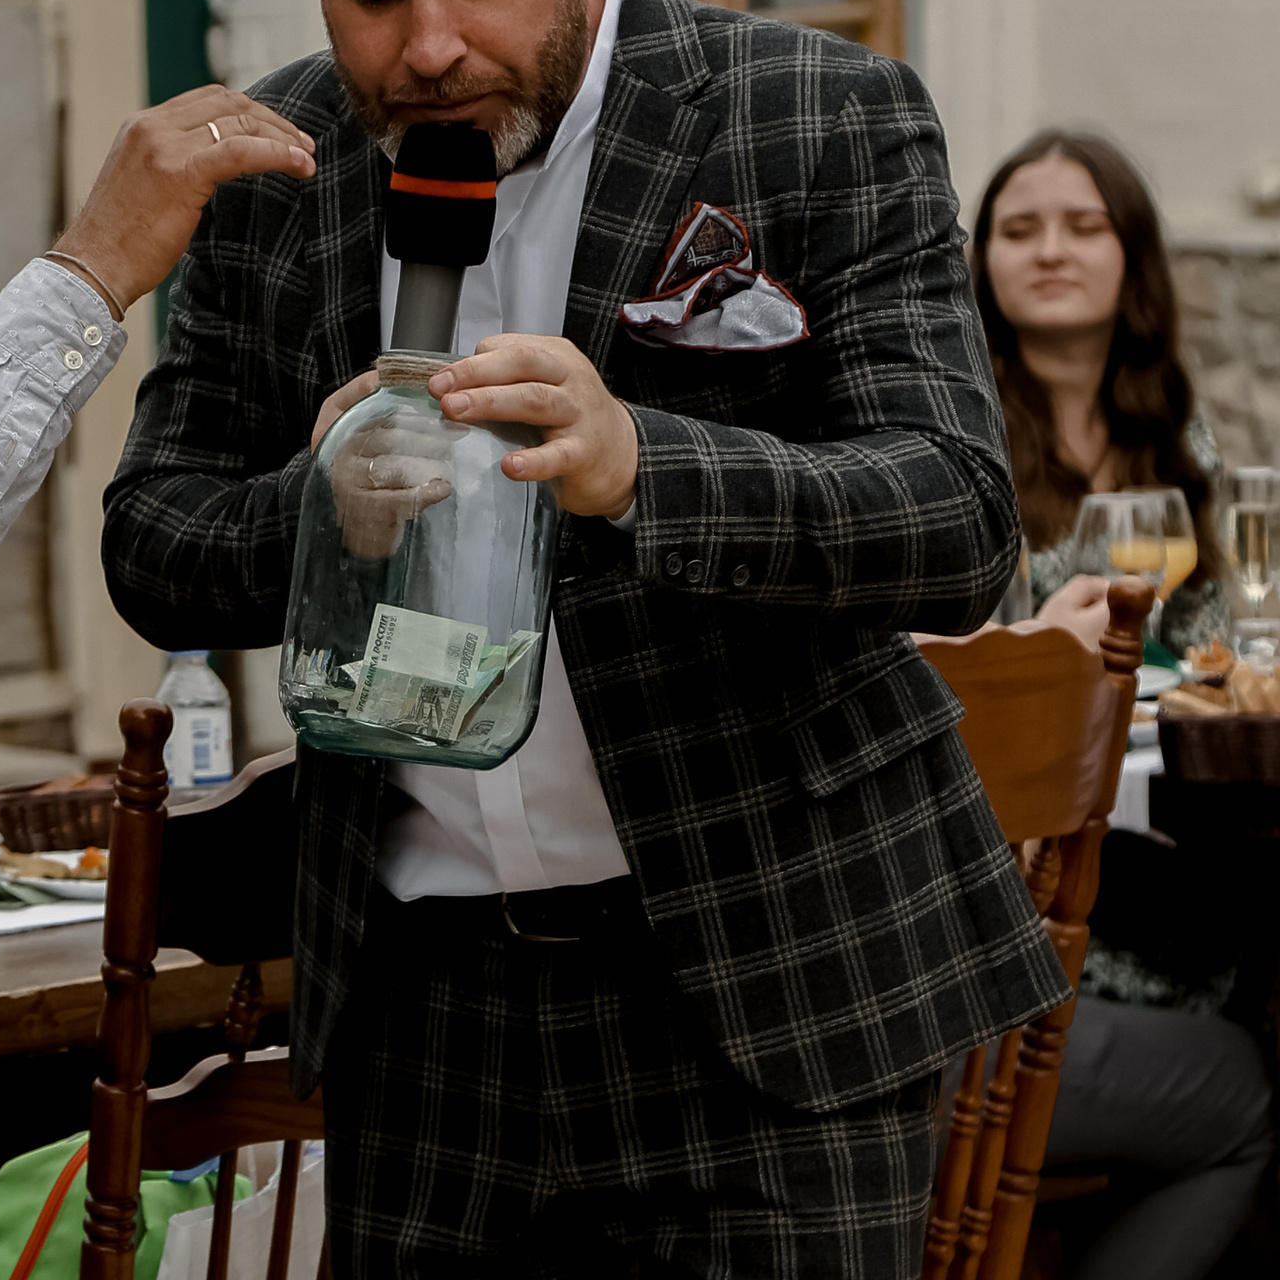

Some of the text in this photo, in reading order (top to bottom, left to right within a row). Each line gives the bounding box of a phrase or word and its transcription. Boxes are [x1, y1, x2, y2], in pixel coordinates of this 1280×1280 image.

[365, 655, 379, 687] БАНКА
[373, 614, 389, 654] РОССИИ
[438, 633, 478, 738] ЯТЬДЕСЯТ РУБЛЕЙ
